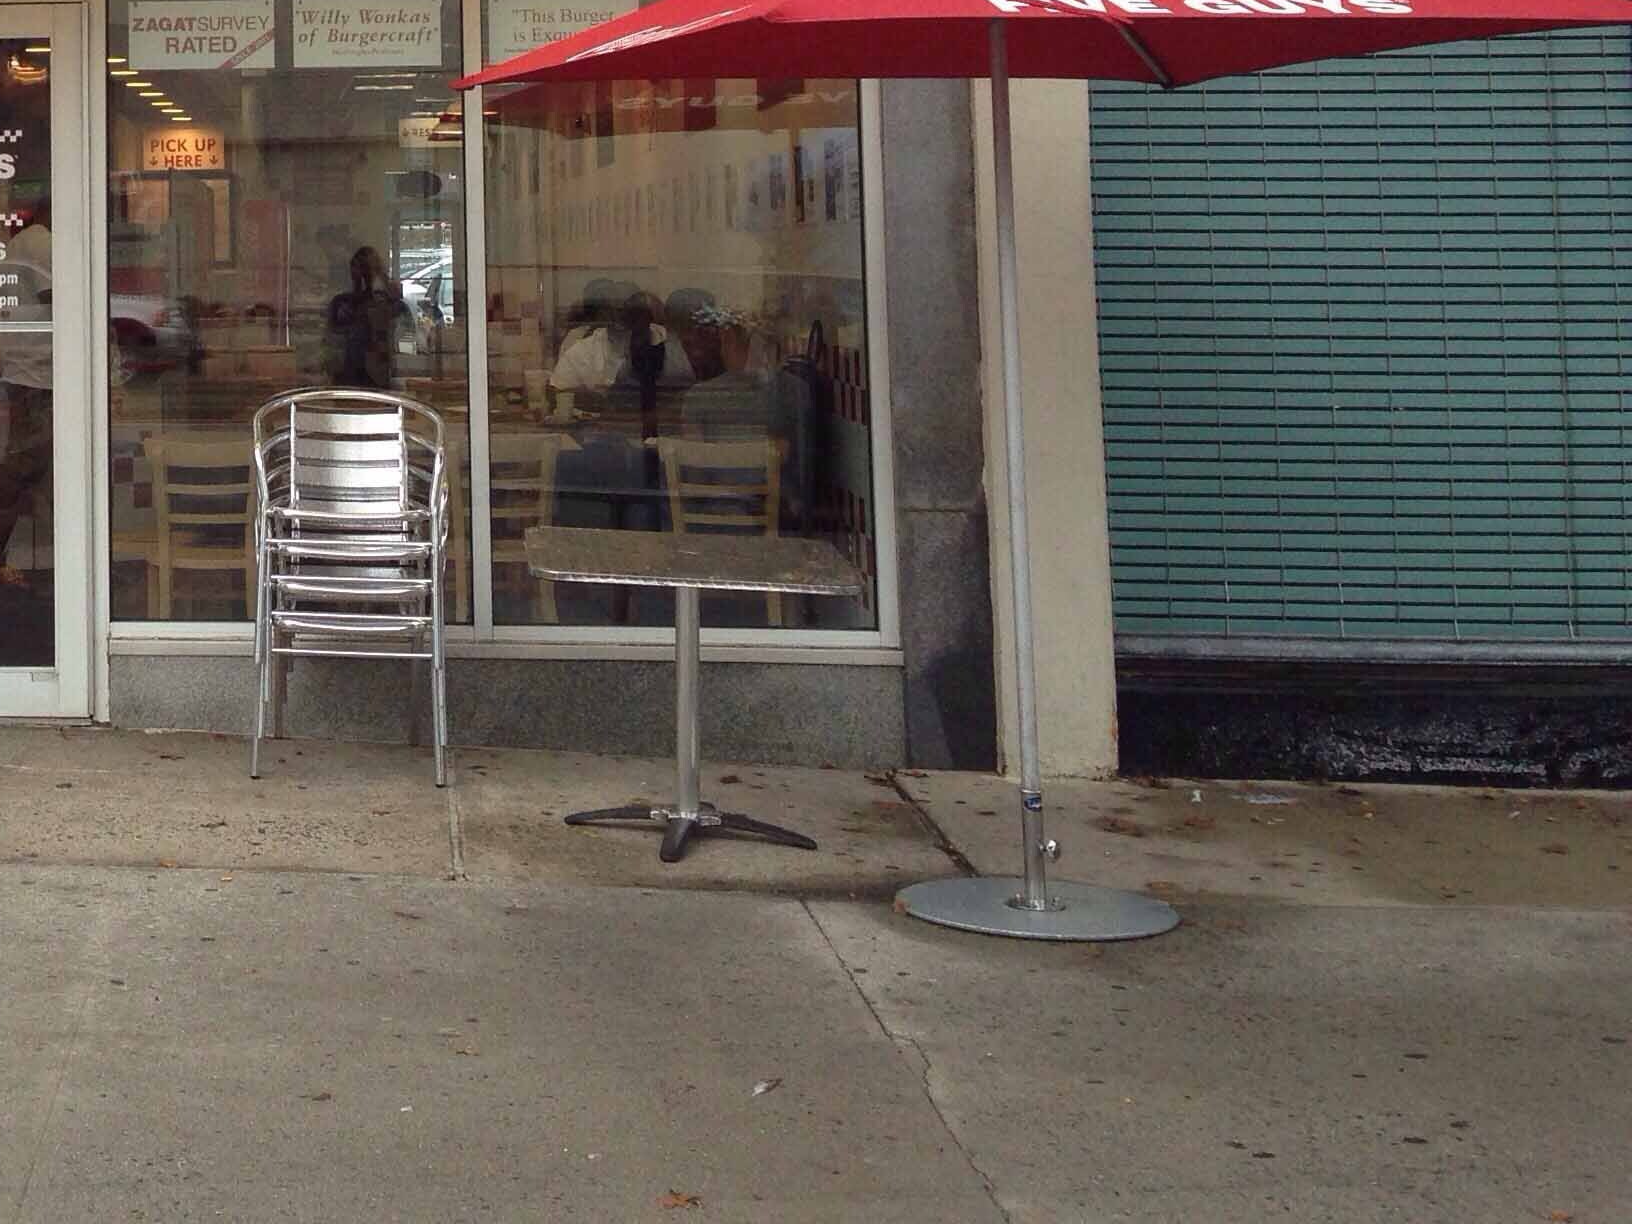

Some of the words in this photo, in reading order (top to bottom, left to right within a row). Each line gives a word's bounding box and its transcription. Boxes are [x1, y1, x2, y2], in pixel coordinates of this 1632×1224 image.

[358, 8, 431, 25] Wonkas
[559, 8, 614, 25] Burger
[297, 28, 319, 47] of
[513, 28, 524, 42] is
[165, 36, 238, 54] RATED
[150, 139, 186, 154] PICK
[194, 138, 216, 152] UP
[164, 155, 202, 167] HERE
[0, 274, 18, 288] pm
[0, 295, 18, 309] pm
